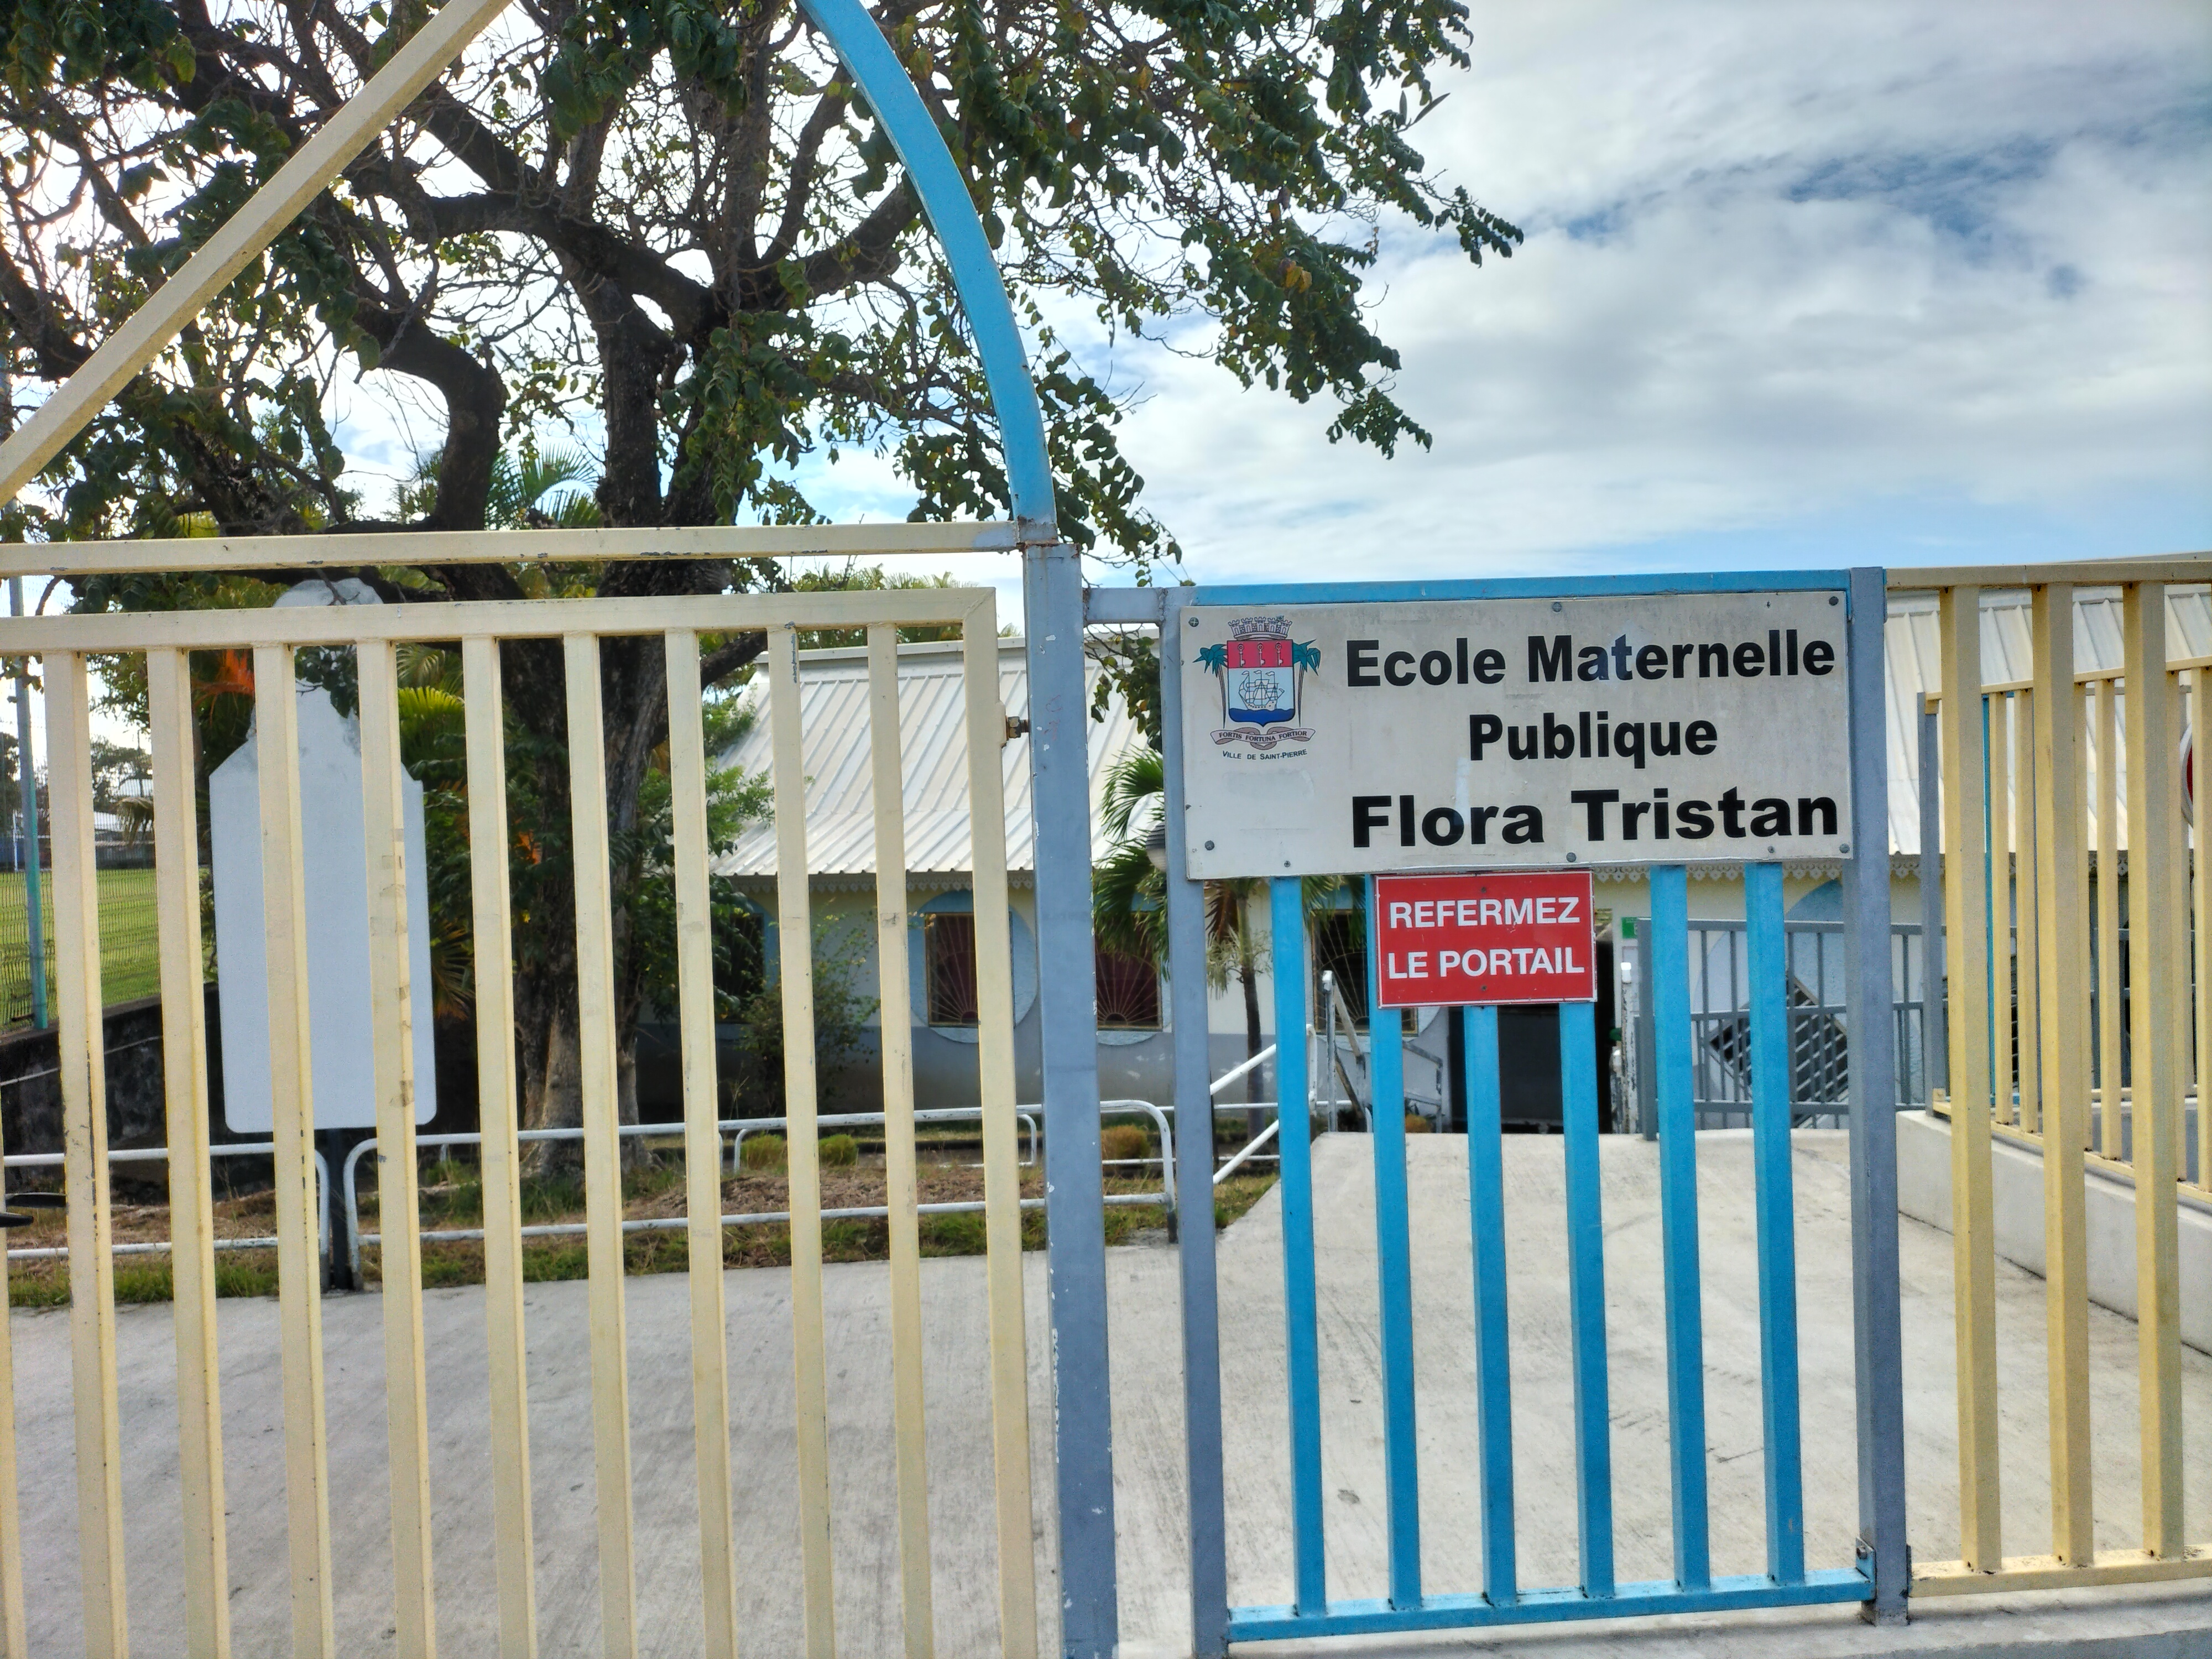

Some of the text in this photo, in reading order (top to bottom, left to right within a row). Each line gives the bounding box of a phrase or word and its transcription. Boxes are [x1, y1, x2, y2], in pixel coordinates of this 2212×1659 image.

[1347, 629, 1835, 687] Ecole Maternelle
[1219, 730, 1243, 739] FORTIS
[1279, 730, 1307, 739] FORTIOR
[1469, 711, 1718, 769] Publique
[1222, 750, 1241, 759] VILLE
[1260, 749, 1307, 760] SAINT-PIERRE
[1352, 786, 1838, 848] Flora Tristan
[1390, 896, 1580, 929] REFERMEZ
[1388, 947, 1585, 979] LE PORTAIL
